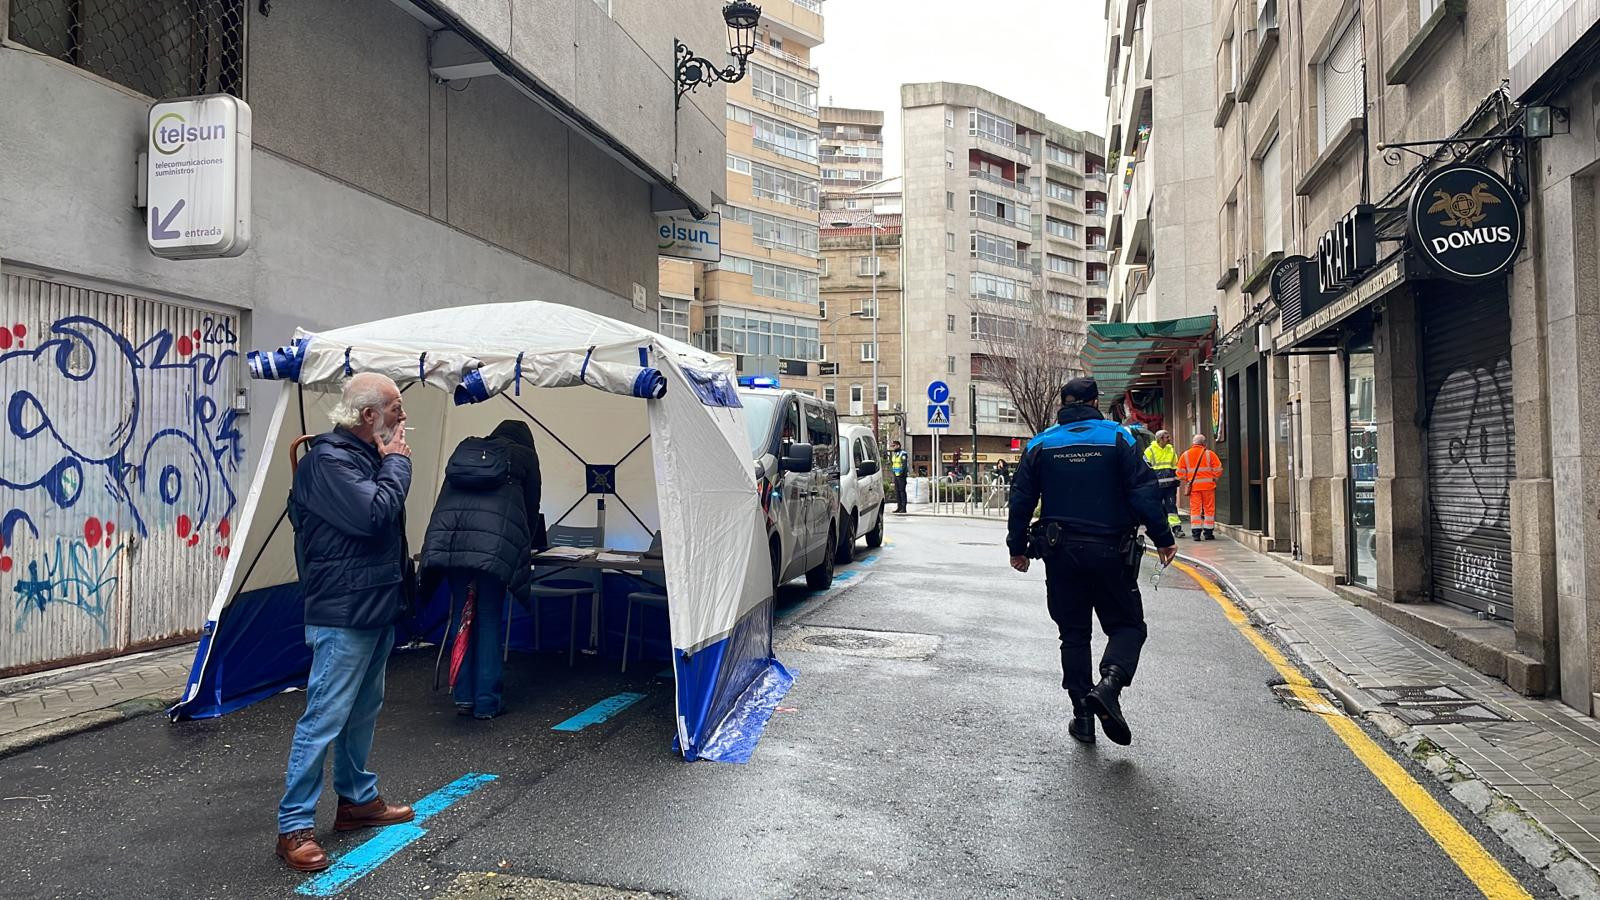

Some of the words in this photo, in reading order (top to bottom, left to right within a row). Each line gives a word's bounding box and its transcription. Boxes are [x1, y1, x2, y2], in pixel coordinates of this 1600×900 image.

[160, 123, 226, 144] telsun
[155, 157, 223, 169] telecomunicaciones
[155, 168, 194, 177] suministros
[185, 224, 222, 238] entrada
[659, 222, 716, 245] elsun
[1431, 226, 1512, 254] DOMUS
[1318, 208, 1358, 293] CRAFT
